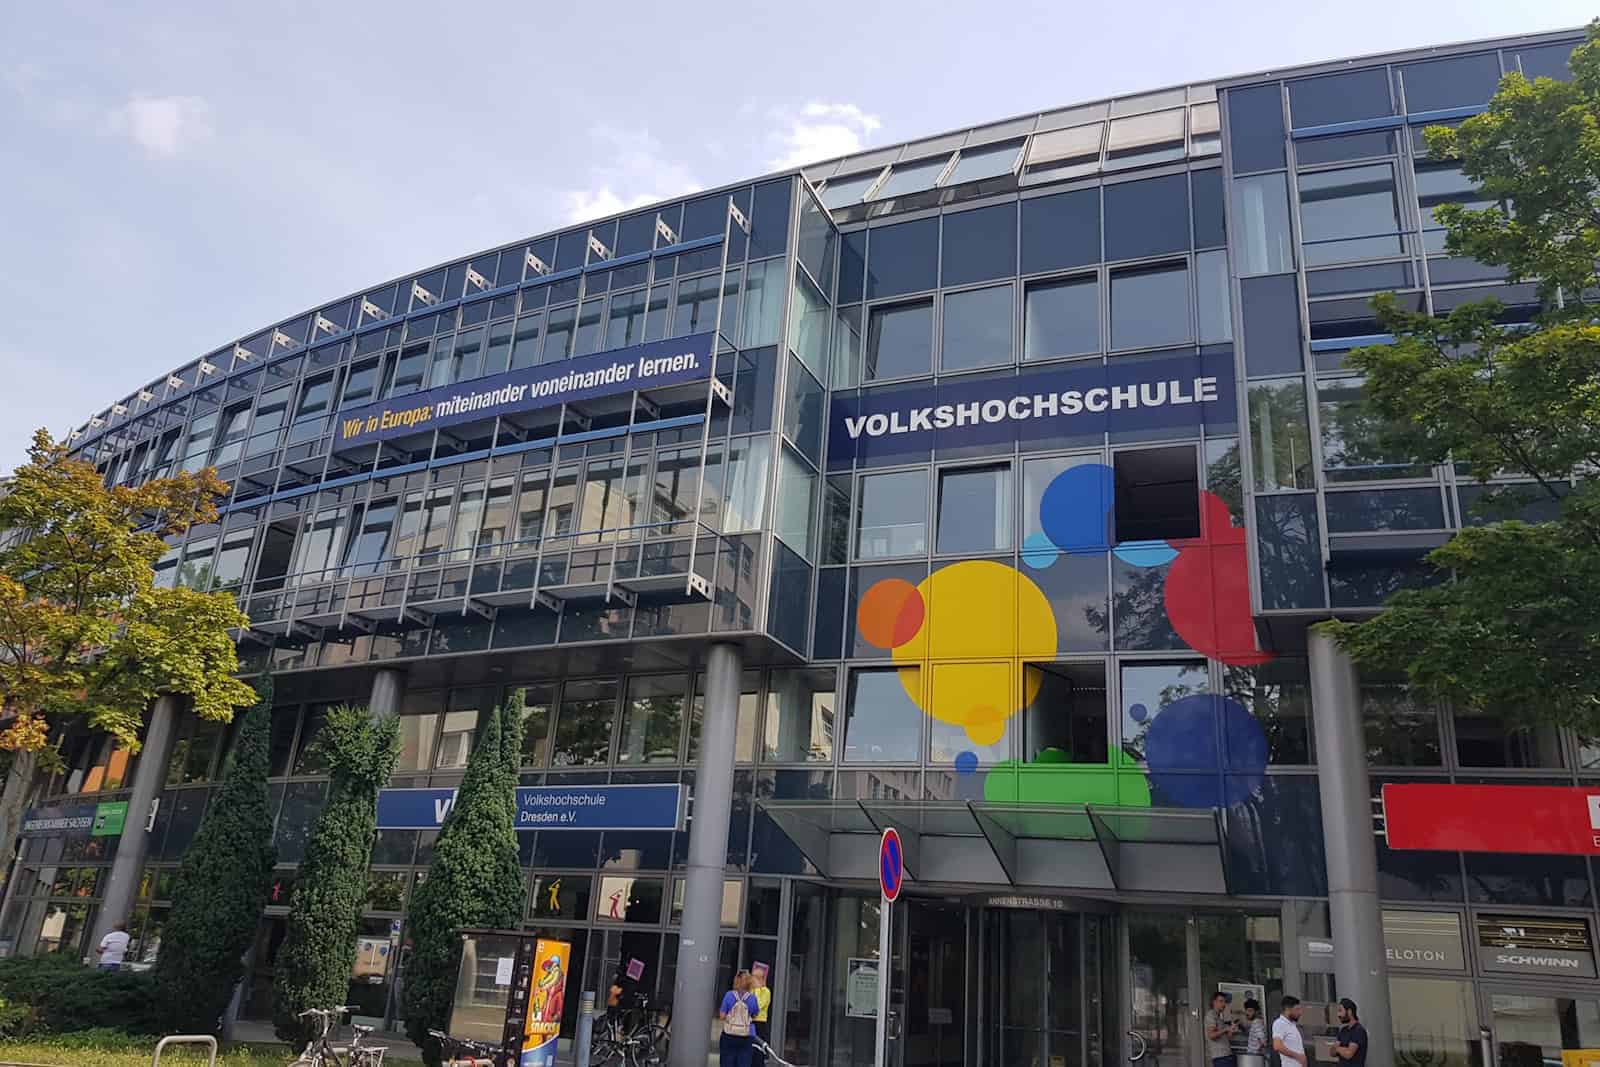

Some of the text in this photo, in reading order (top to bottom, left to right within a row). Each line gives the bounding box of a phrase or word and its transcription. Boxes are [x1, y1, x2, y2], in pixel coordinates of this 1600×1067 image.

[343, 352, 699, 439] Wir in Europa: miteinander voneinander lernen.
[845, 376, 1218, 439] VOLKSHOCHSCHULE
[524, 793, 606, 806] Volkshochschule
[520, 811, 577, 823] Dresden e.V.
[1386, 948, 1445, 961] ELOTON
[1496, 954, 1579, 968] SCHWINN
